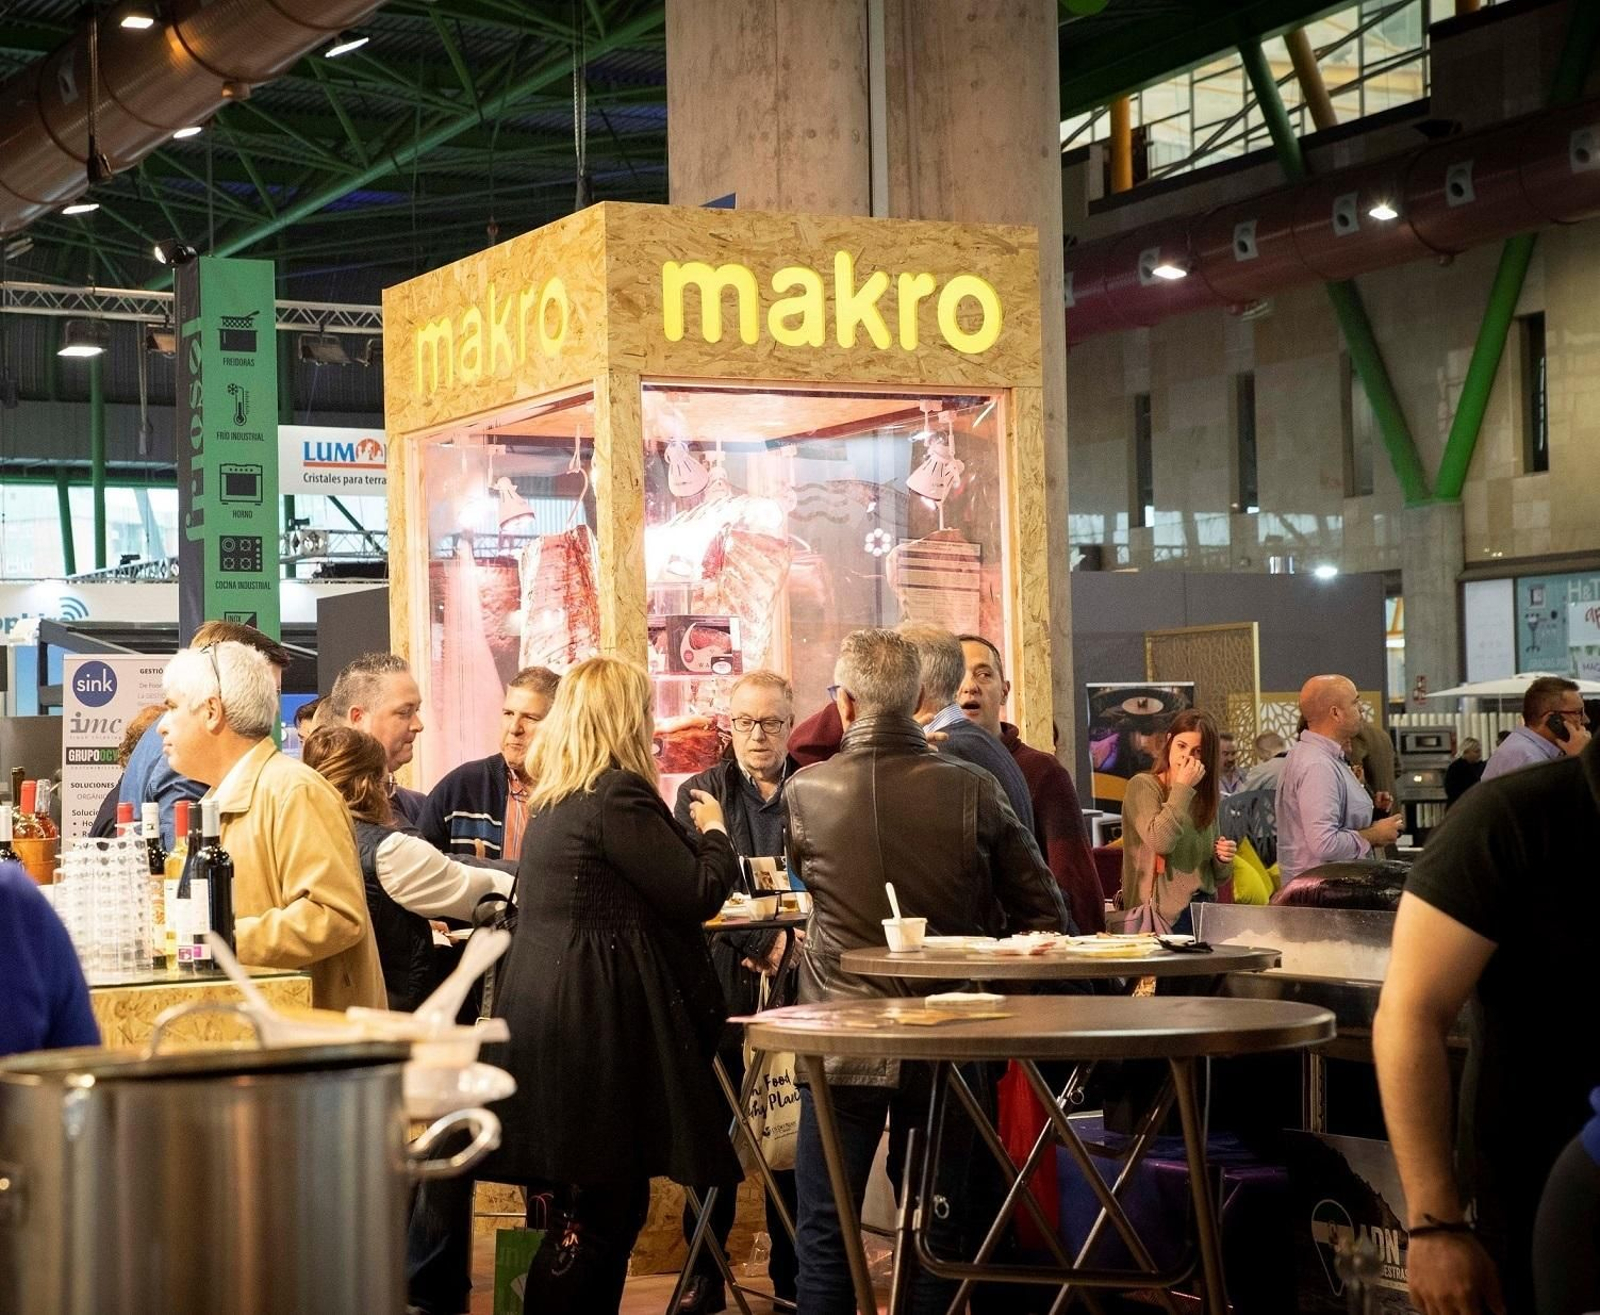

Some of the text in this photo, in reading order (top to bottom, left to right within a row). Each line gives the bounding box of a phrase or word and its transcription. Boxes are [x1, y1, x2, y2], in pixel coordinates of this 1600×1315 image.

[661, 250, 1003, 354] makro
[415, 276, 570, 395] makro
[222, 357, 255, 367] FREIDORAS
[231, 431, 264, 441] INDUSTRIAL
[303, 472, 387, 486] Cristales para terra
[232, 509, 253, 519] HORNO
[215, 580, 271, 590] COCINA INDUSTRIAL
[76, 668, 113, 692] sink
[763, 1068, 792, 1091] Food
